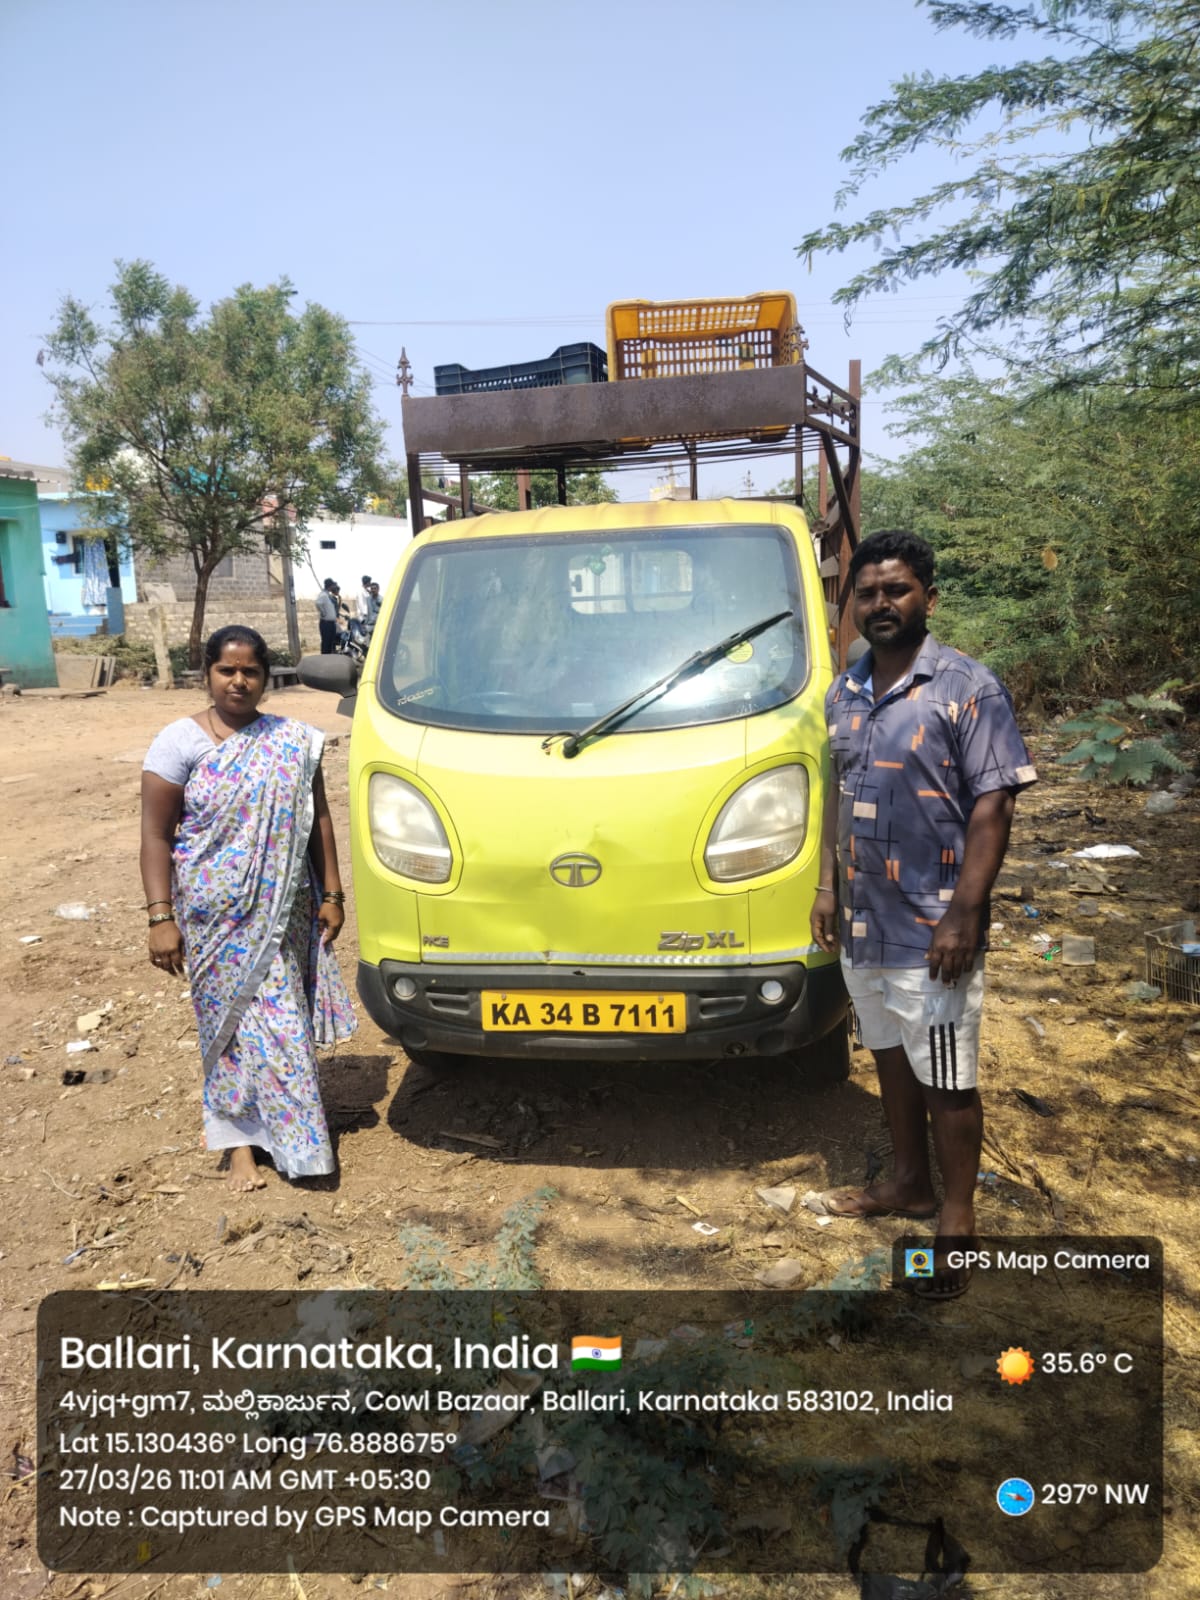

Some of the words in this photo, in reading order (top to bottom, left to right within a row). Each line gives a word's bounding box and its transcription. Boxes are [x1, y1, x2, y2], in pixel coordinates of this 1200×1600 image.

[706, 930, 745, 949] XL
[491, 1002, 532, 1026] KA
[540, 1002, 573, 1026] 34
[582, 1002, 600, 1026] B
[610, 1003, 675, 1028] 7111
